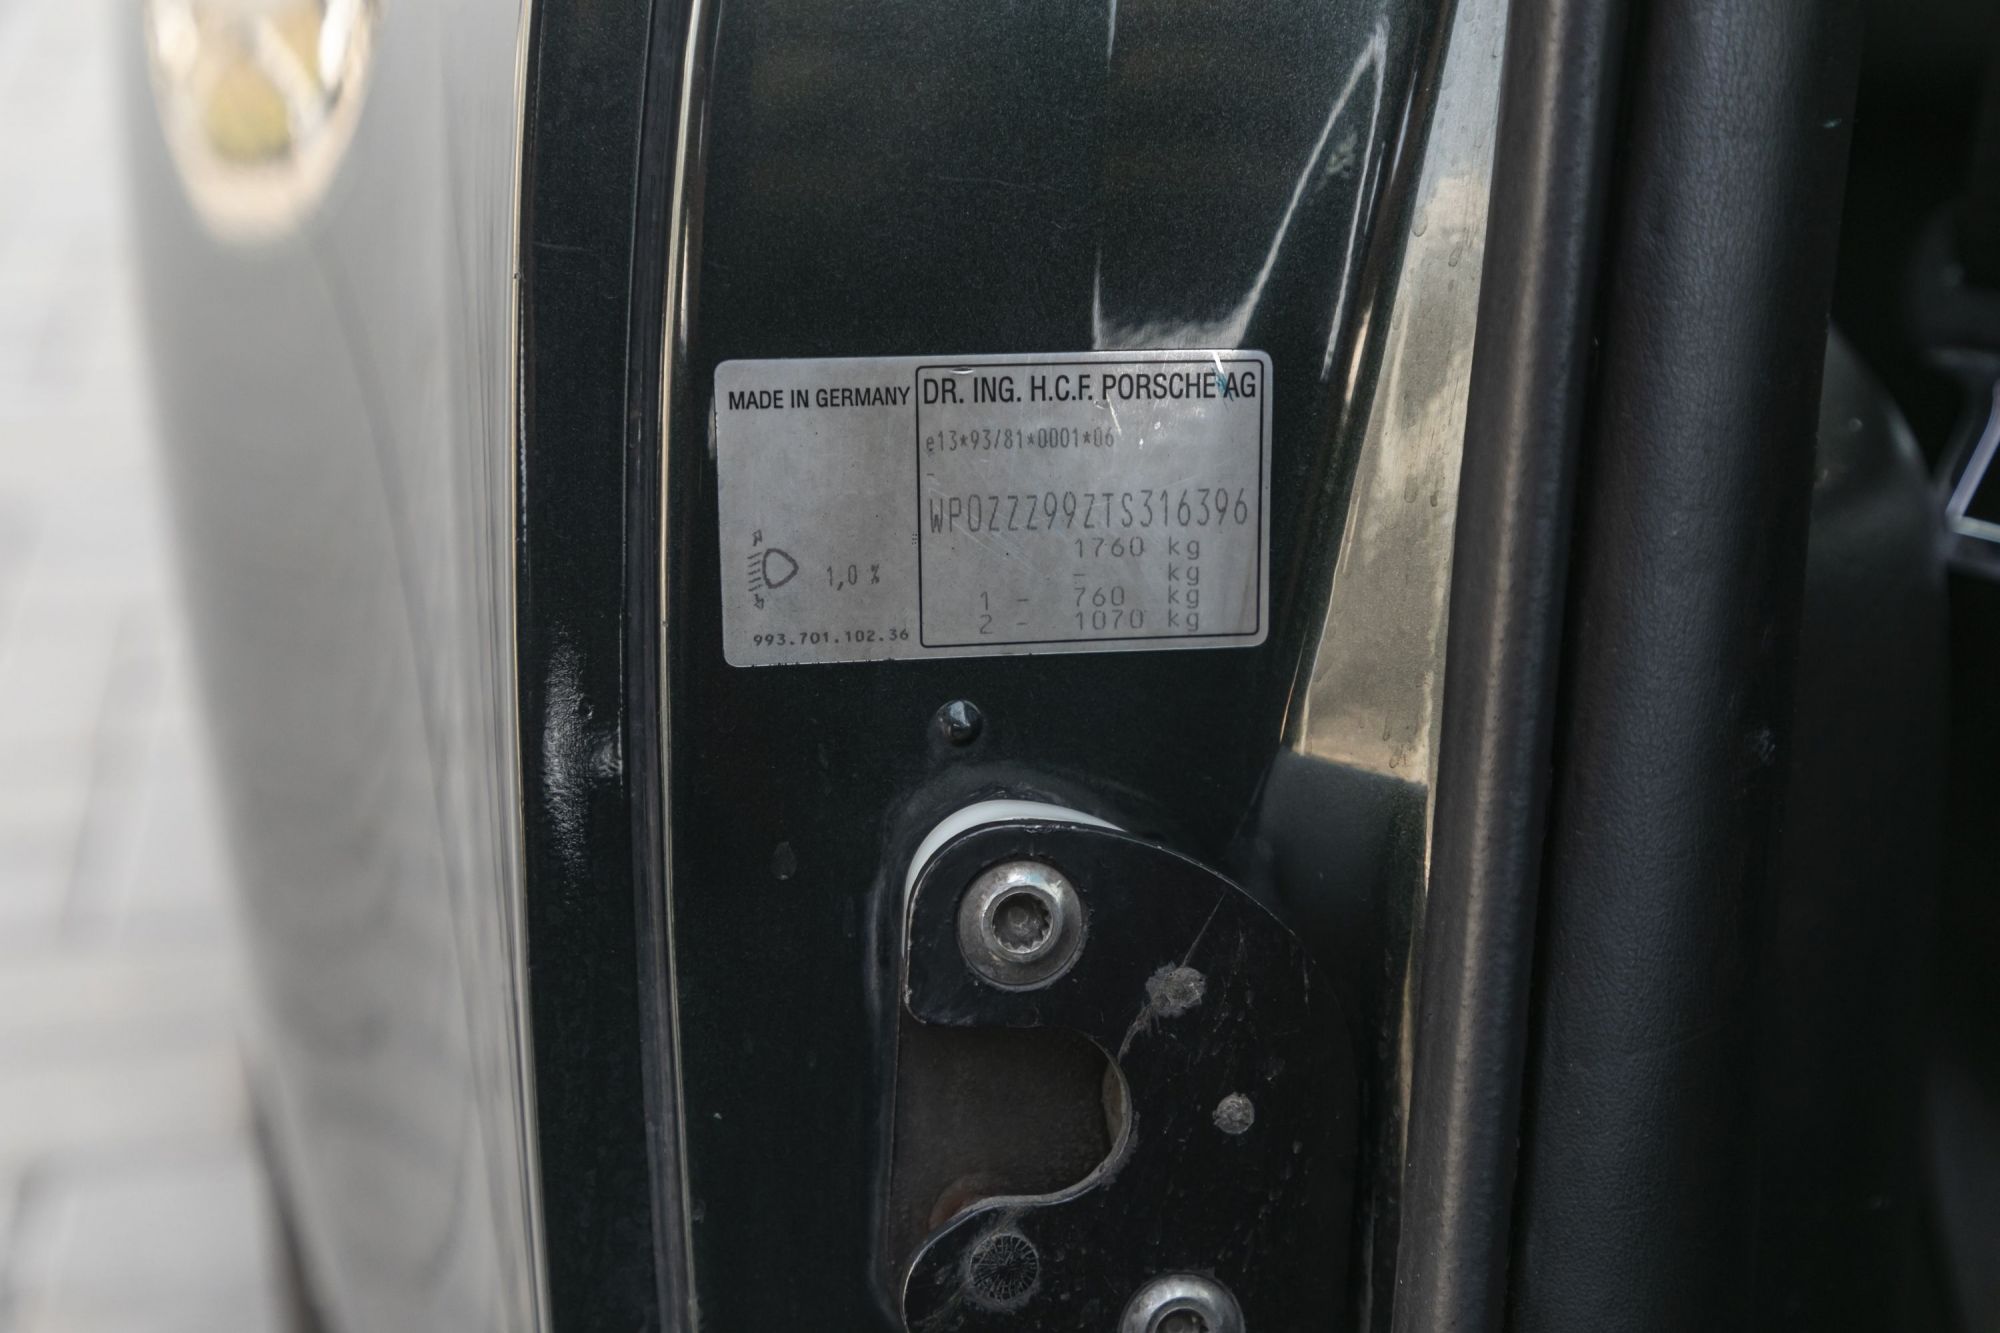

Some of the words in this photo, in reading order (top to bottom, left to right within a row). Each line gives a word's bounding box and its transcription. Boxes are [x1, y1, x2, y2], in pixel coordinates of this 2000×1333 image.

[728, 390, 784, 411] MADE
[790, 388, 809, 409] IN
[815, 386, 911, 408] GERMANY
[923, 377, 965, 405] DR.
[973, 375, 1022, 403] ING.
[1102, 372, 1216, 400] PORSCHE
[1223, 371, 1256, 399] AG
[1074, 536, 1145, 559] 1760
[1168, 535, 1201, 561] kg
[826, 563, 858, 591] 1,0
[869, 562, 881, 585] %
[1168, 562, 1201, 587] kg
[979, 590, 989, 611] 1
[1073, 586, 1125, 608] 760
[1167, 585, 1200, 610] kg
[979, 613, 993, 635] 2
[1073, 608, 1145, 631] 1070
[1167, 608, 1200, 633] kg
[752, 627, 910, 647] 993.701.102.36
